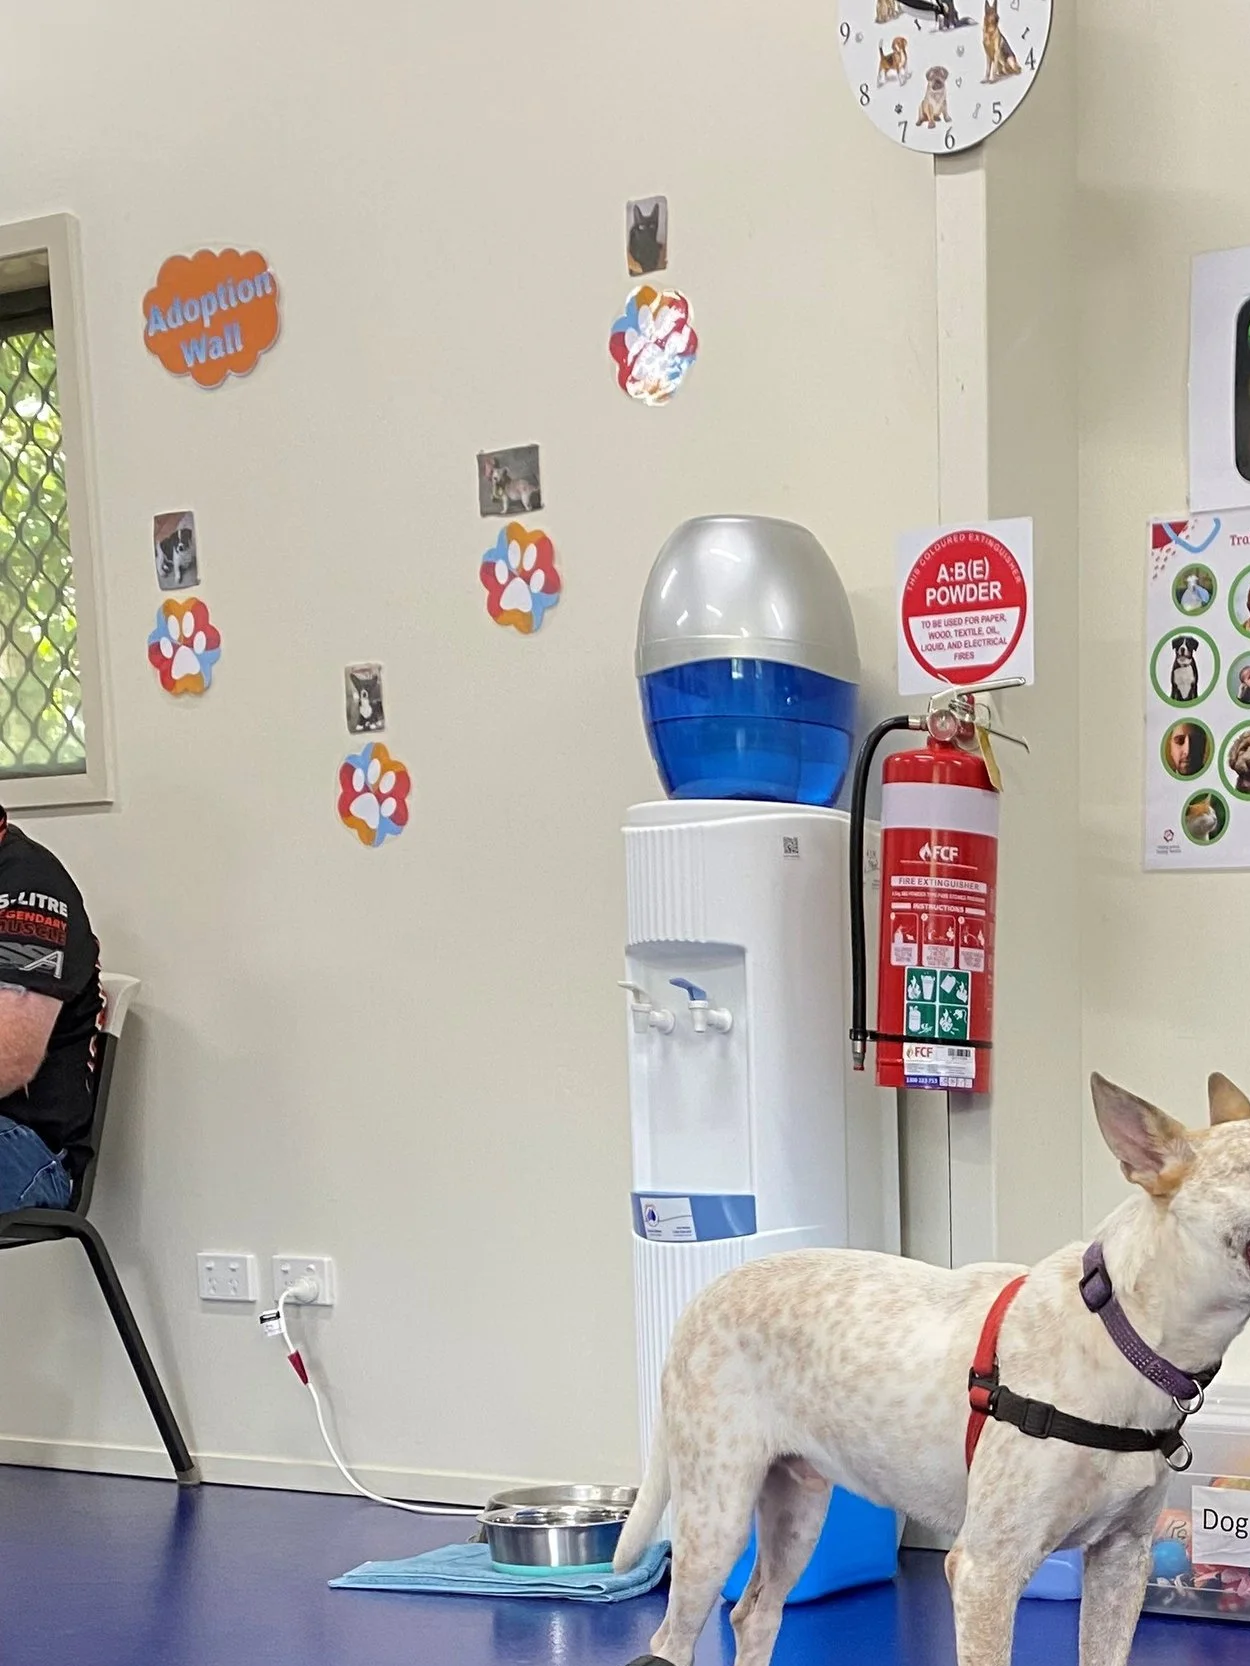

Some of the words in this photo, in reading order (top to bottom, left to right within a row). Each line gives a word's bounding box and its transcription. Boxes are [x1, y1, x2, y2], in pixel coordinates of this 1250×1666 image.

[839, 21, 851, 45] 9
[1024, 47, 1036, 71] 4
[859, 83, 870, 106] 8
[991, 101, 1002, 125] 5
[897, 120, 908, 144] 7
[944, 126, 955, 150] 6
[147, 269, 273, 337] Adoption
[180, 319, 244, 368] Wall
[906, 567, 921, 592] THIS
[919, 533, 966, 568] COLOURED
[968, 532, 1022, 585] EXTINGUISHER
[925, 580, 1003, 608] POWDER
[921, 620, 931, 629] TO
[932, 619, 942, 628] BE
[943, 617, 963, 627] USED
[964, 615, 980, 625] FOR
[947, 640, 962, 650] AND
[963, 637, 1008, 649] ELECTRICAL
[953, 651, 975, 661] FIRES
[932, 845, 959, 862] FCF
[898, 877, 916, 886] FIRE
[917, 878, 980, 891] EXTINGUISHER
[914, 1046, 933, 1058] FCF
[1203, 1508, 1249, 1539] Dog
